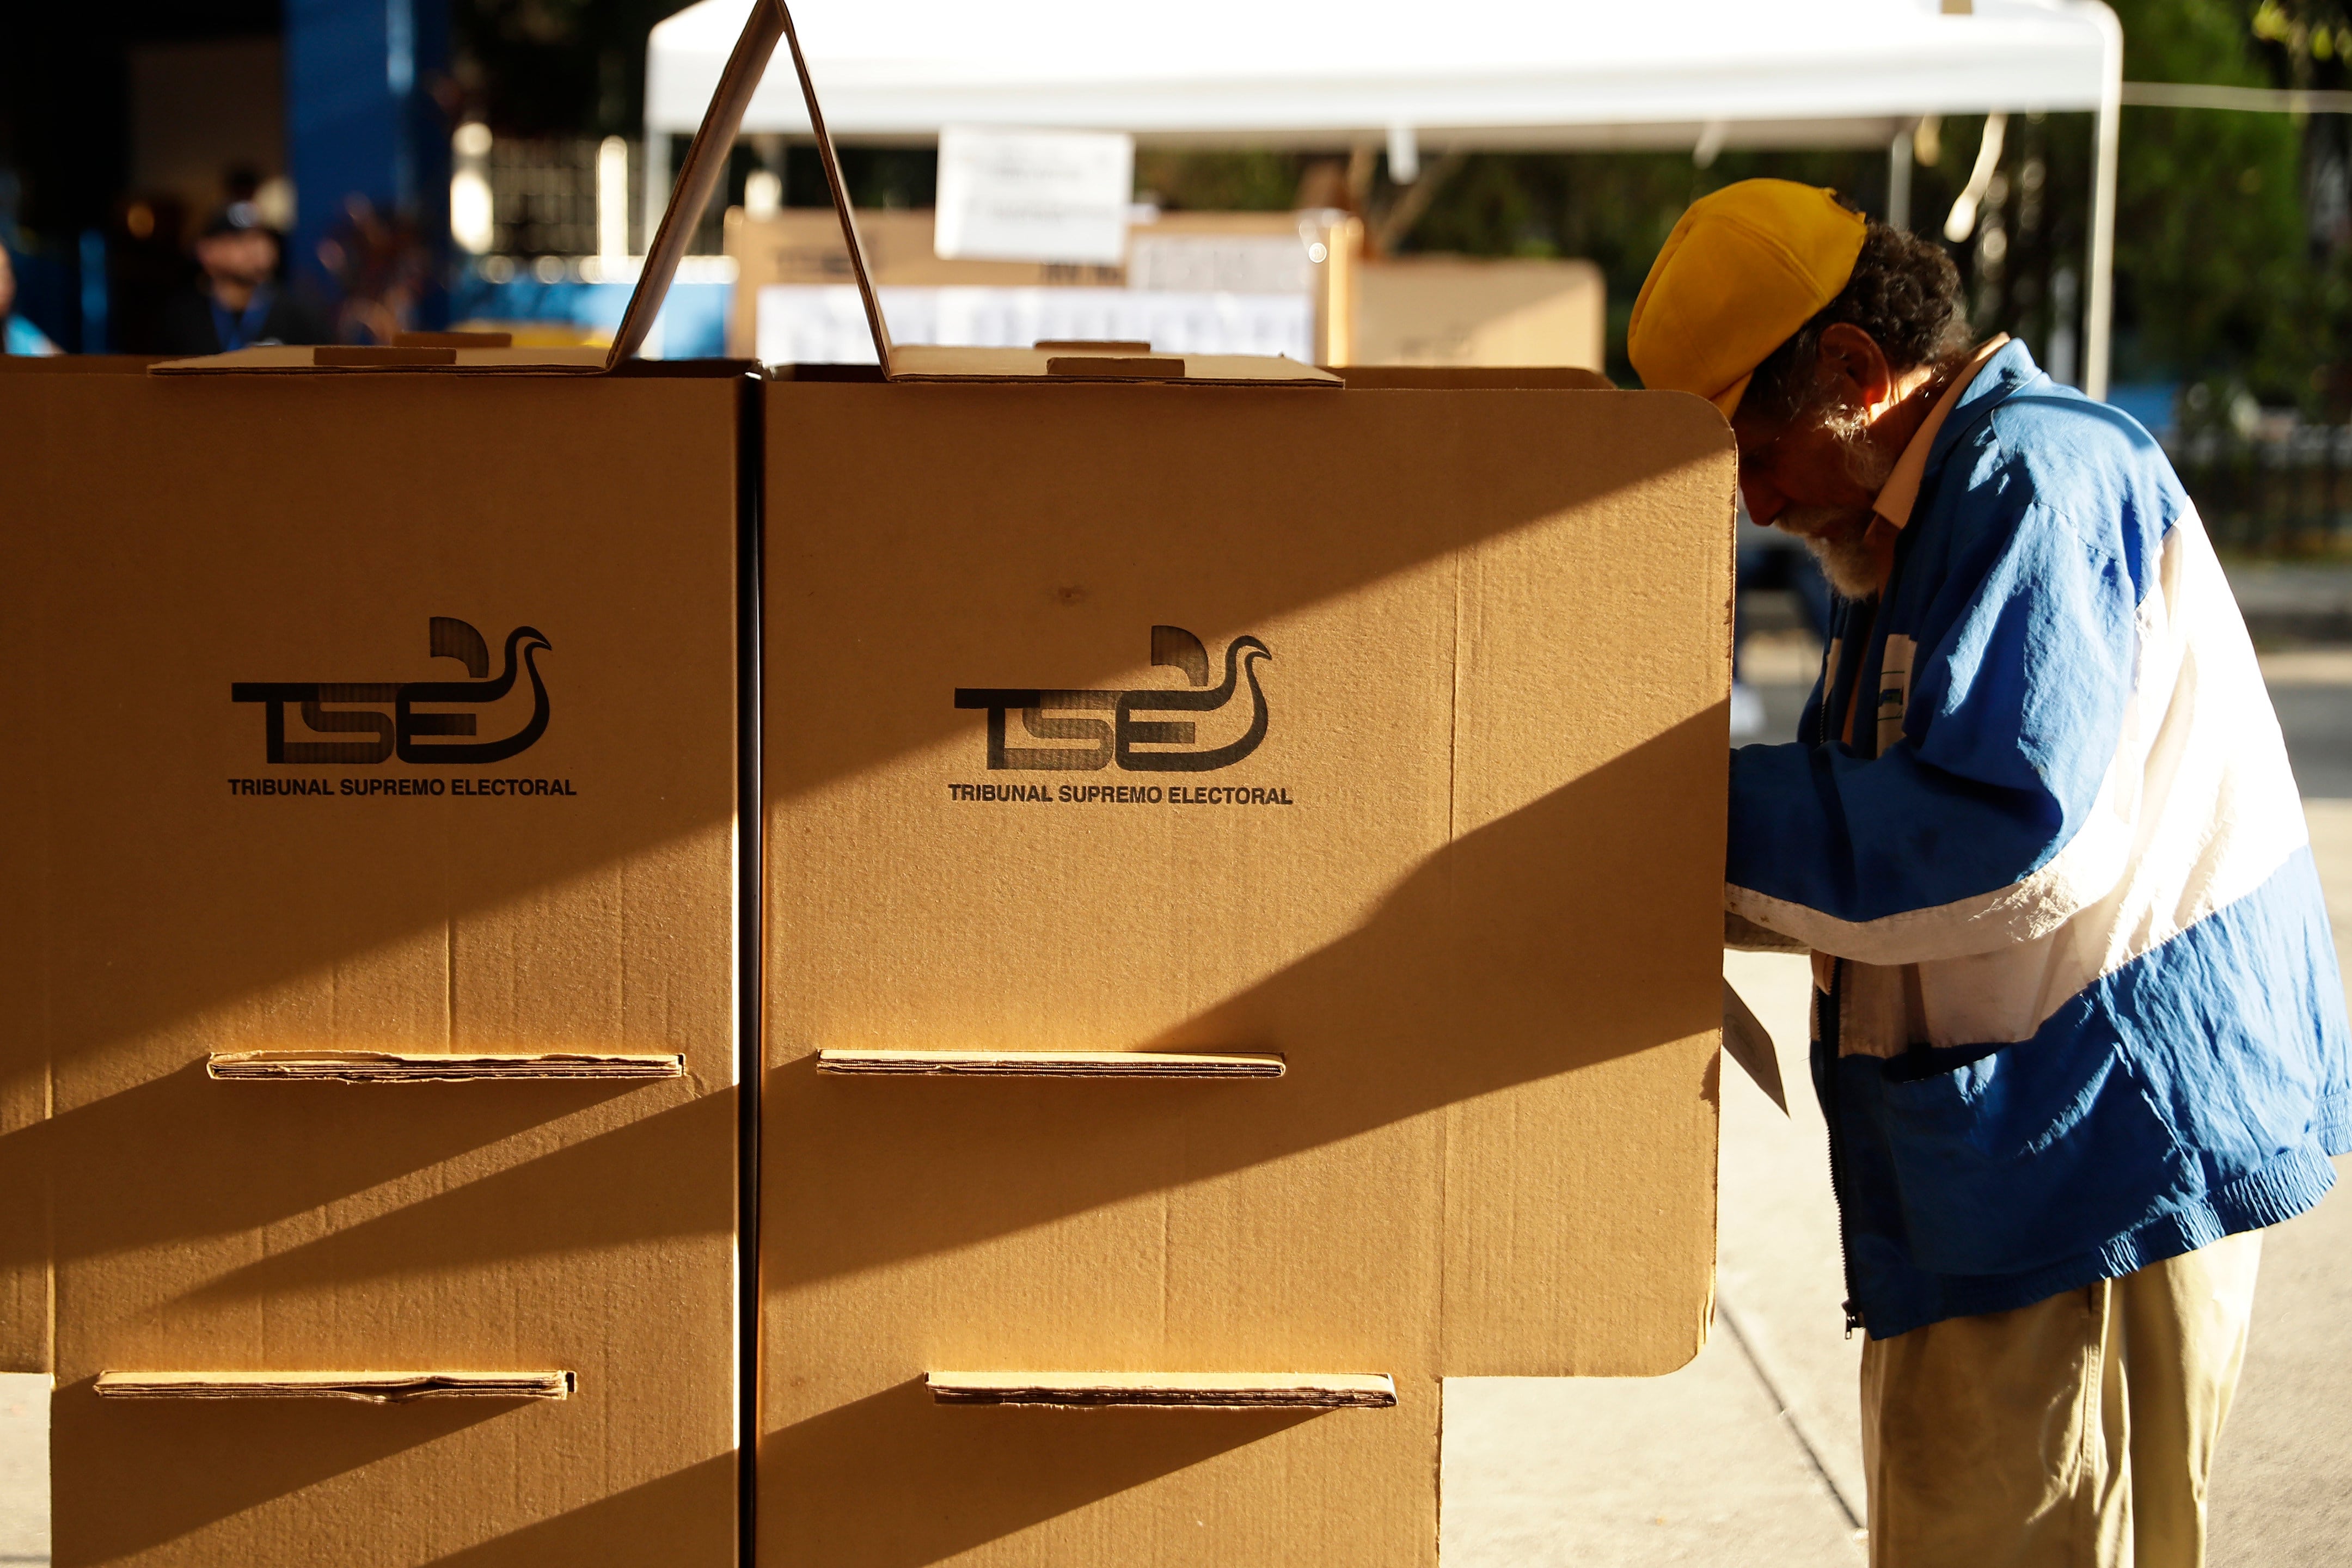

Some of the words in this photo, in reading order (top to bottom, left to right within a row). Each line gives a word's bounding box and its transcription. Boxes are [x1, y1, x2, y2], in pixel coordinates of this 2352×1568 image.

[231, 626, 552, 764] TSE
[954, 635, 1272, 772] TSE
[228, 779, 334, 796] TRIBUNAL
[340, 779, 445, 796] SUPREMO
[451, 779, 577, 796] ELECTORAL
[948, 783, 1054, 803] TRIBUNAL
[1058, 785, 1162, 804] SUPREMO
[1168, 786, 1294, 805] ELECTORAL
